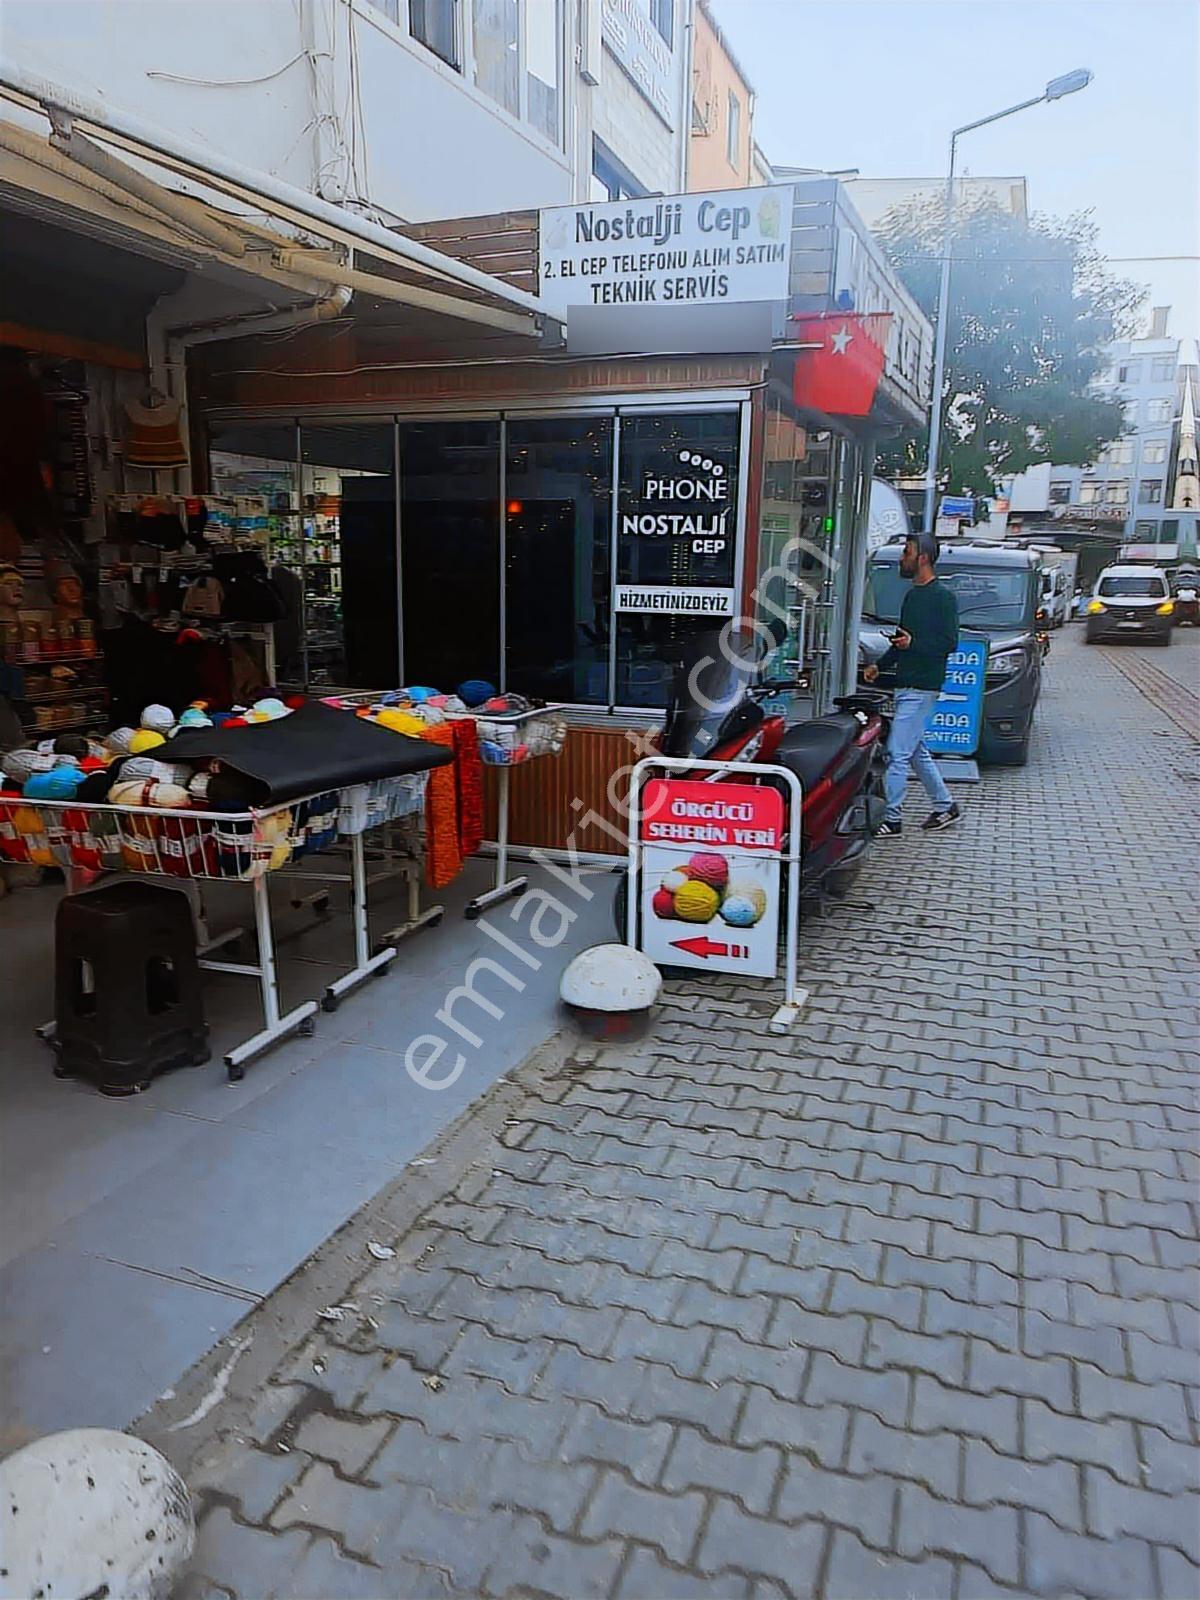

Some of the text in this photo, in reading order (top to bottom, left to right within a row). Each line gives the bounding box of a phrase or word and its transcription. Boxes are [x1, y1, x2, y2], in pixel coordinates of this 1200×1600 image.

[576, 199, 750, 246] Nostalji Cep
[544, 243, 786, 279] 2. EL CEP TELEFONU ALIM SATIM
[591, 268, 729, 304] TEKNİK SERVİS
[646, 479, 727, 500] PHONE
[692, 539, 726, 554] CEP
[619, 589, 728, 611] HİZMETİNİZDEYİZ
[671, 798, 754, 821] ÖRGÜCÜ
[649, 822, 775, 846] SEHERİN YERİ
